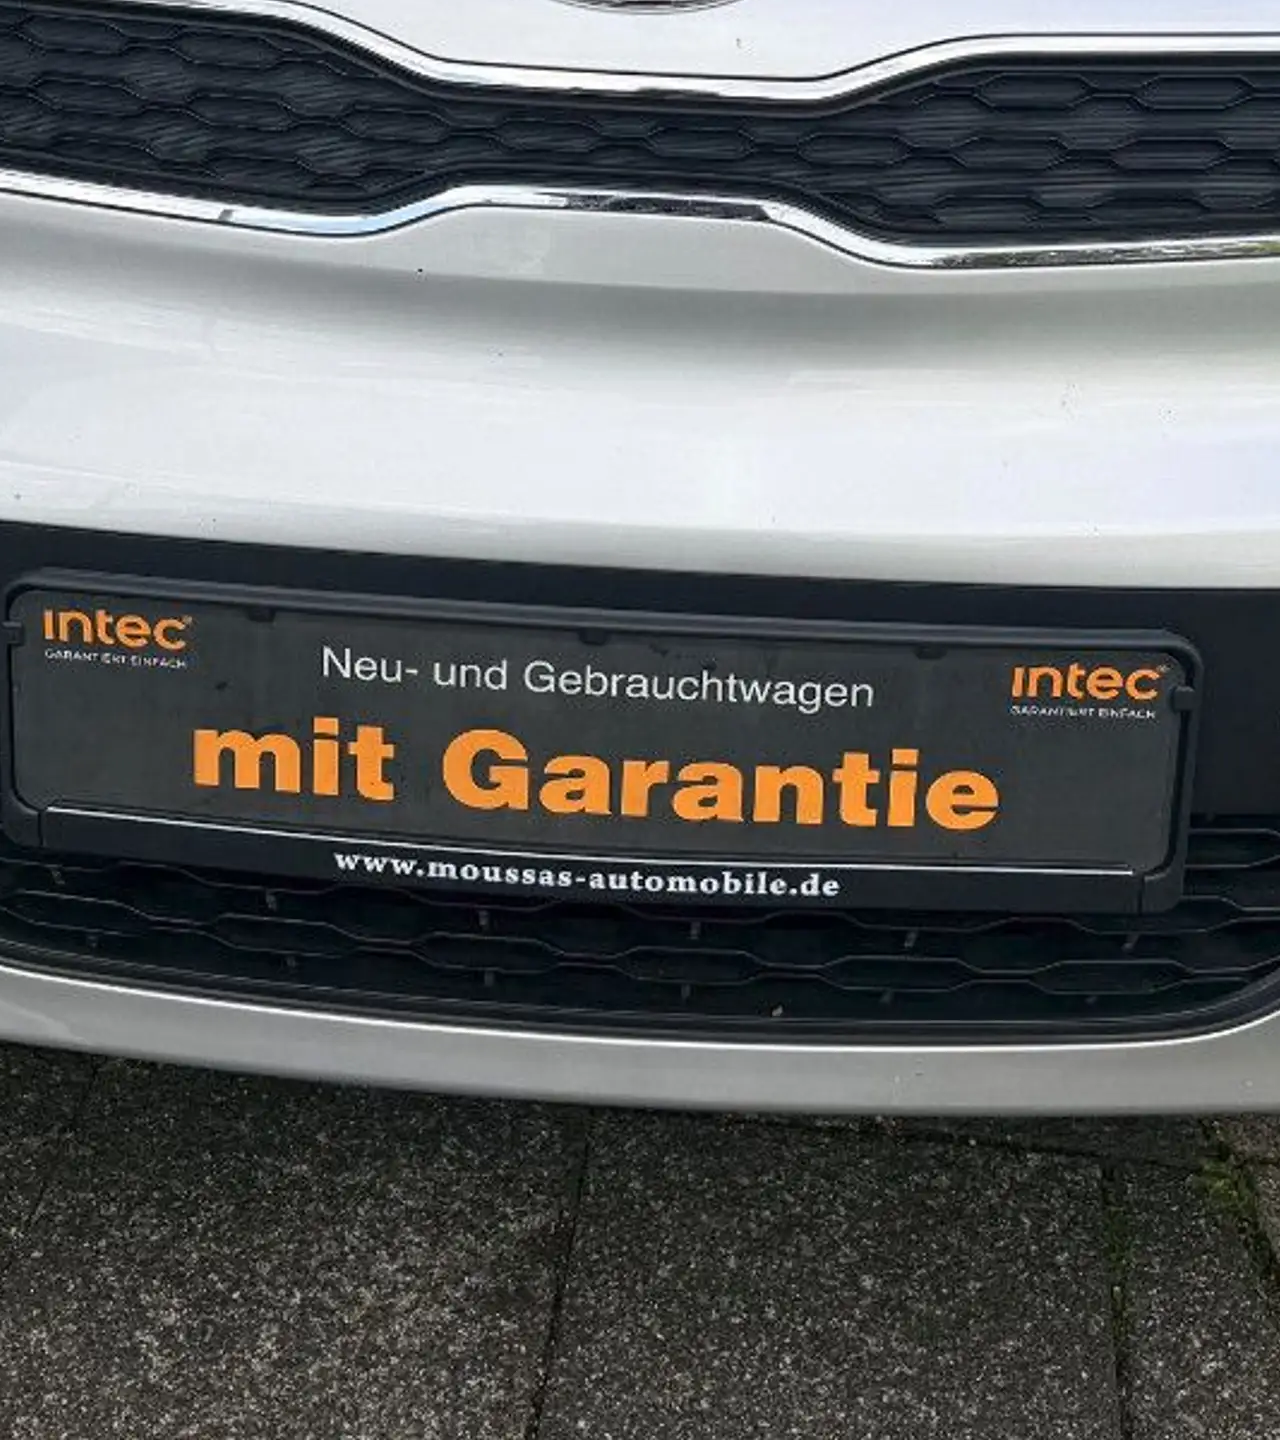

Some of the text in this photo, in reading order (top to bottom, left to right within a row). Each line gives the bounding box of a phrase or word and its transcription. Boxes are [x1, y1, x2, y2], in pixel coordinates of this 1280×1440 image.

[43, 609, 187, 652] intec
[321, 646, 874, 715] Neu- und Gebrauchtwagen
[1011, 662, 1161, 701] intec
[192, 716, 1000, 832] mit Garantie
[333, 849, 841, 898] www.moussas-automobile.de
